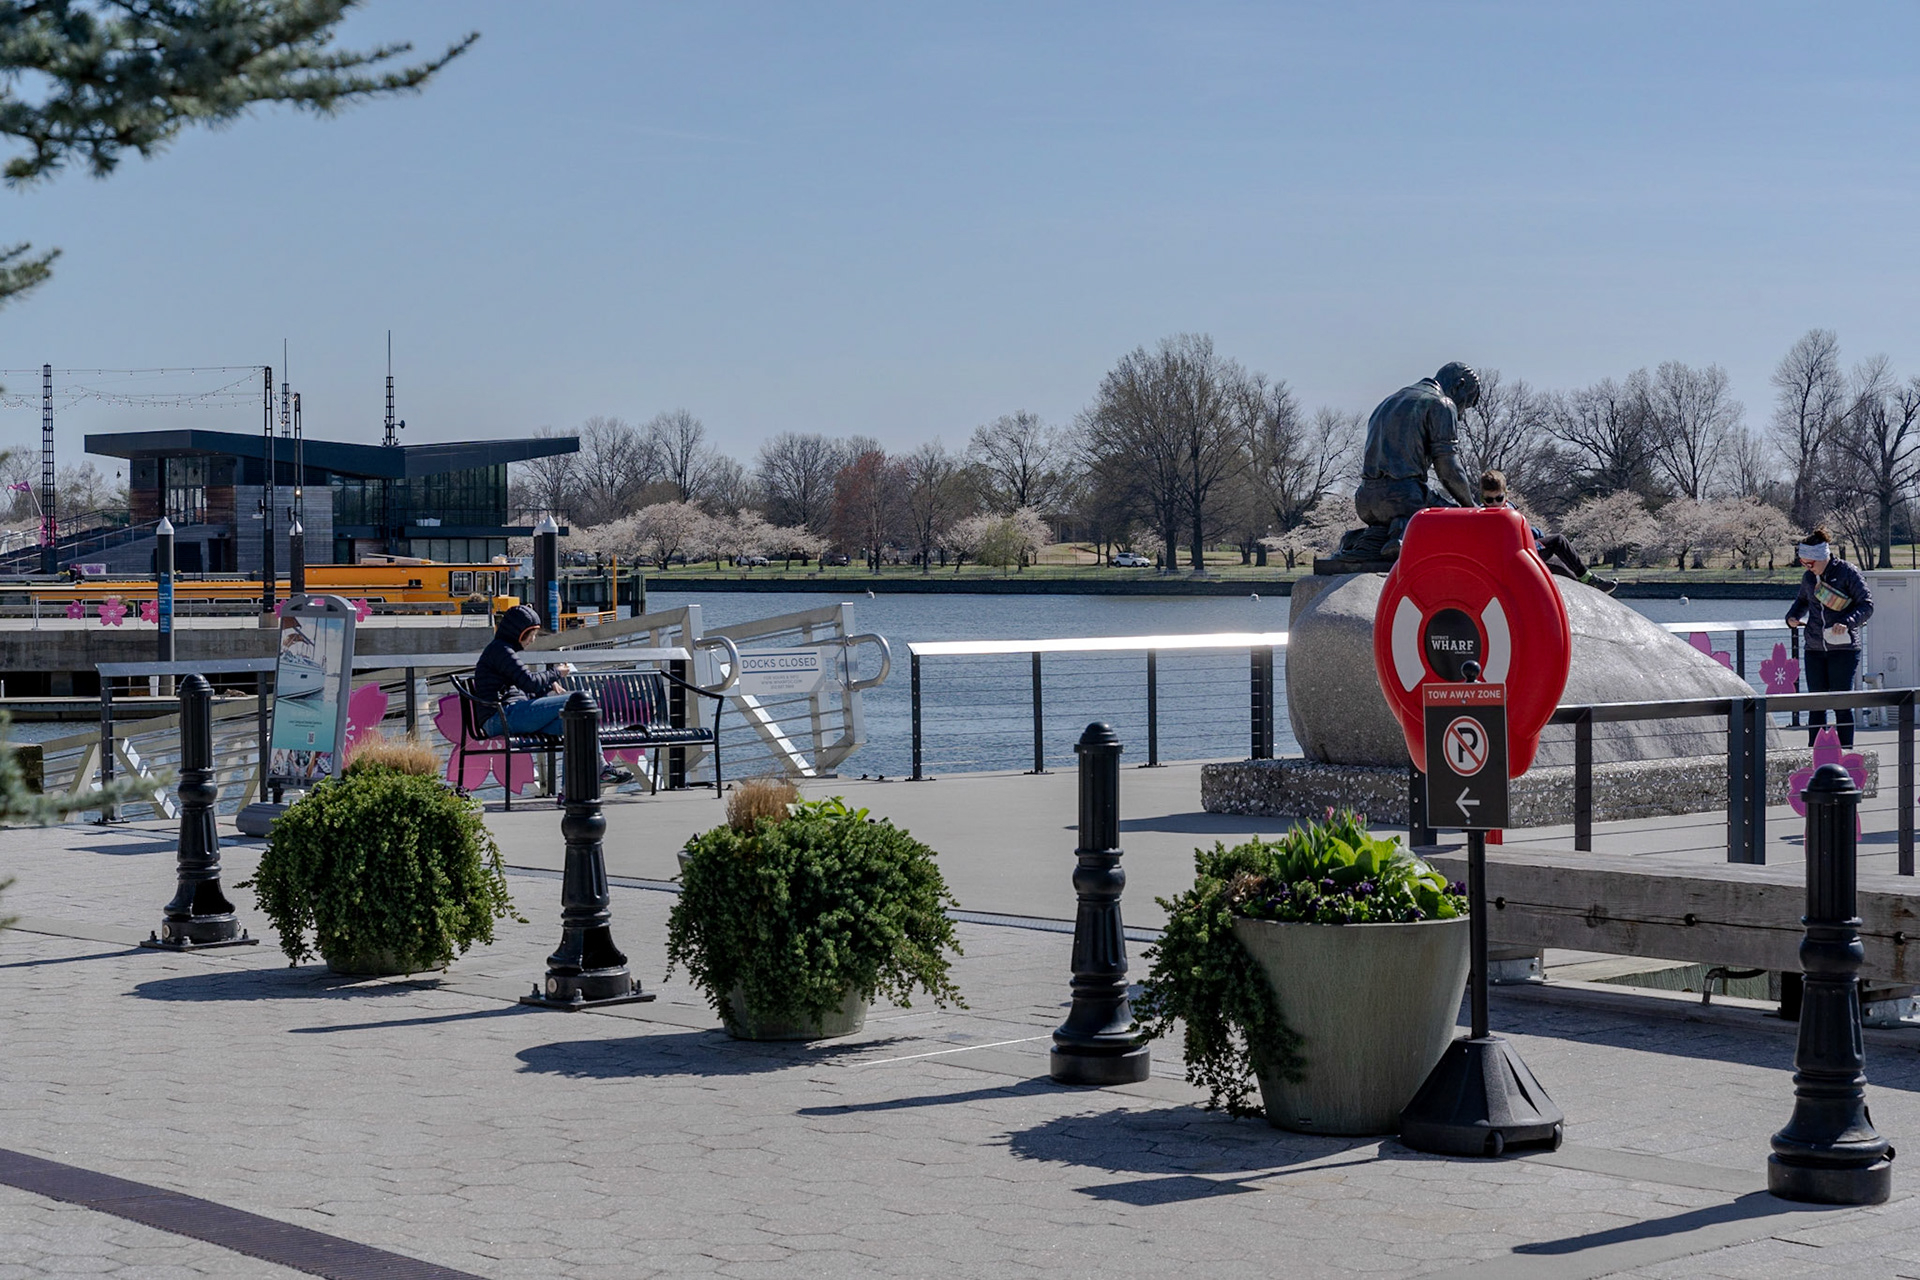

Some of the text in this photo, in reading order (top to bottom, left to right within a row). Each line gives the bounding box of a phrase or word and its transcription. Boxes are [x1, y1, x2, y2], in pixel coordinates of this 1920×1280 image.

[1431, 640, 1474, 651] WHARF
[742, 657, 817, 669] DOCKS CLOSED
[1428, 689, 1501, 699] TOW AWAY ZONE
[1457, 728, 1478, 763] P
